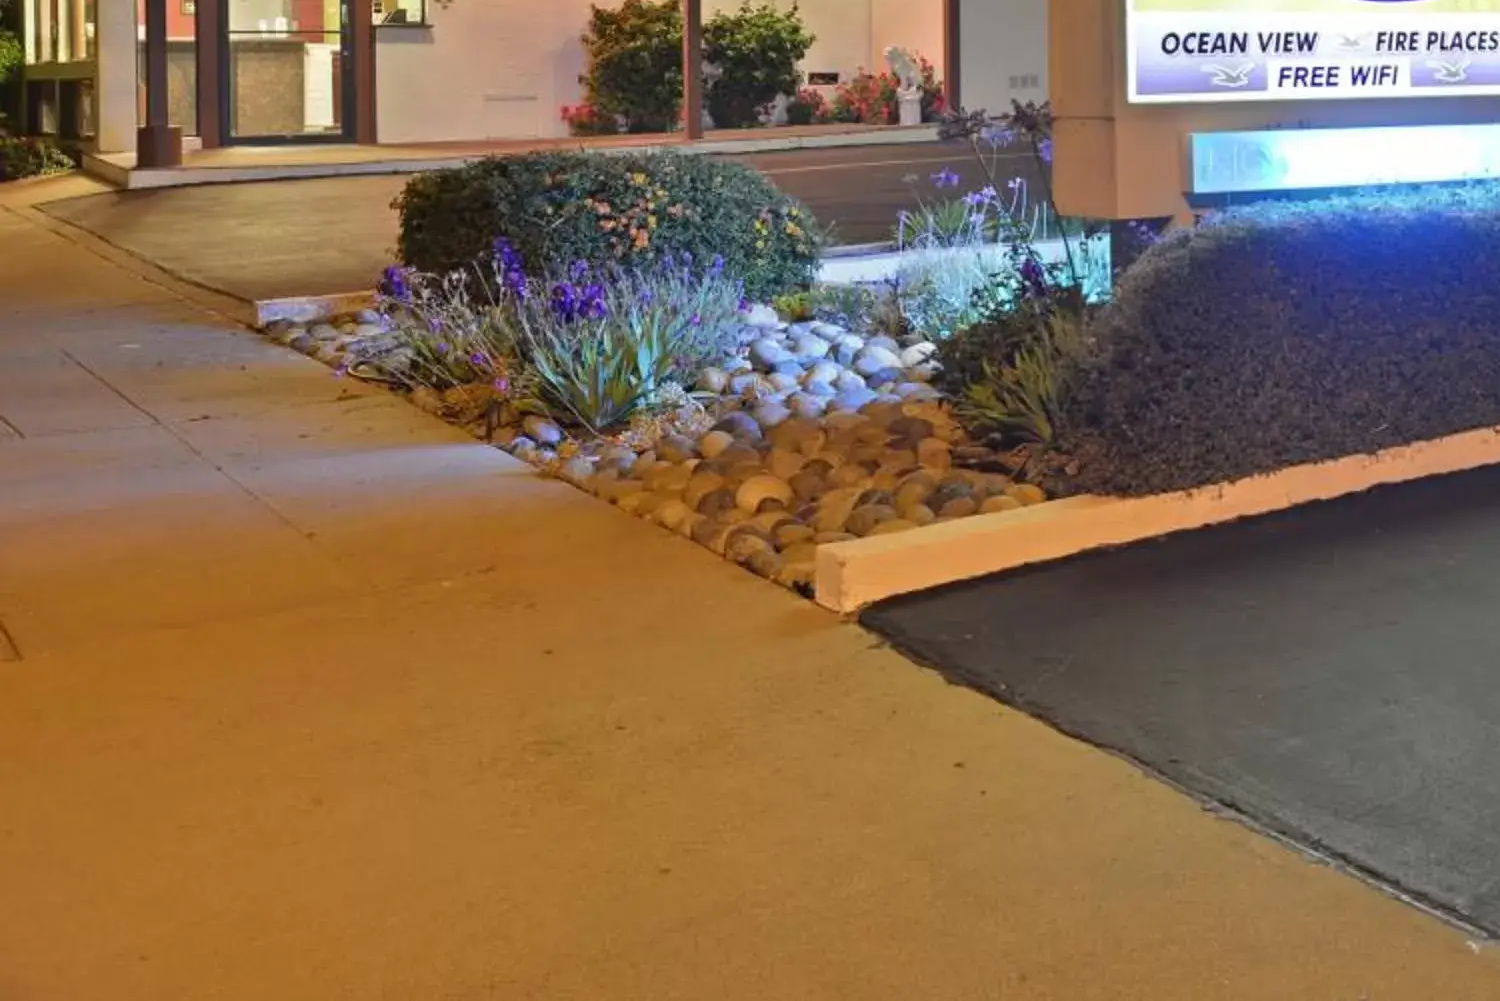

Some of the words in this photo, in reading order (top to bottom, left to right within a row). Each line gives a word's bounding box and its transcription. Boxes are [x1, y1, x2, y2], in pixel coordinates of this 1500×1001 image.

[1160, 31, 1249, 55] OCEAN
[1257, 30, 1319, 53] VIEW
[1375, 30, 1420, 52] FIRE
[1426, 30, 1500, 51] PLACES
[1277, 65, 1340, 88] FREE
[1350, 65, 1399, 86] WIFI
